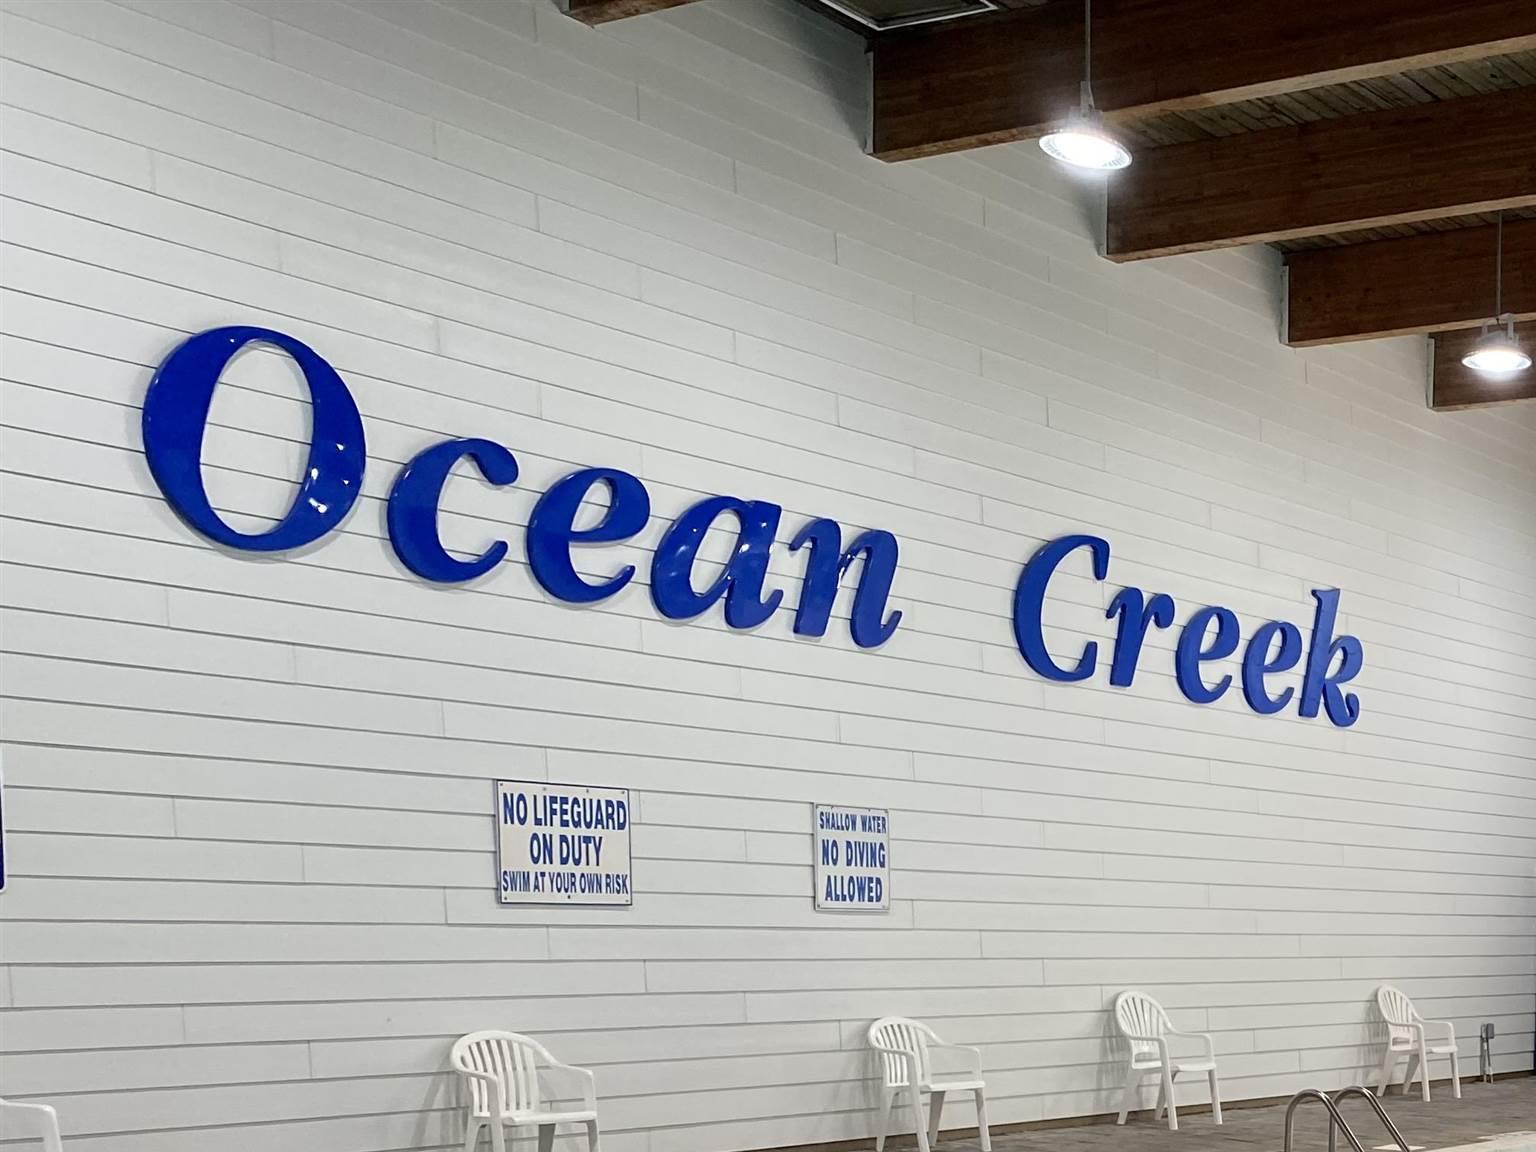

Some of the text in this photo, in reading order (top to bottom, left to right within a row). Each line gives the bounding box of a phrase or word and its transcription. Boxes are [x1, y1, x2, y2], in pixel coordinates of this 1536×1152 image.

[139, 326, 1362, 727] Ocean Creek
[503, 792, 627, 830] NO LIFEGUARD
[819, 811, 887, 834] SHALLOW WATER
[530, 832, 603, 866] ON DUTY
[821, 838, 886, 868] NO DIVING
[502, 870, 629, 895] SWIM AT YOUR OWN RISK
[825, 874, 883, 903] ALLOWED
